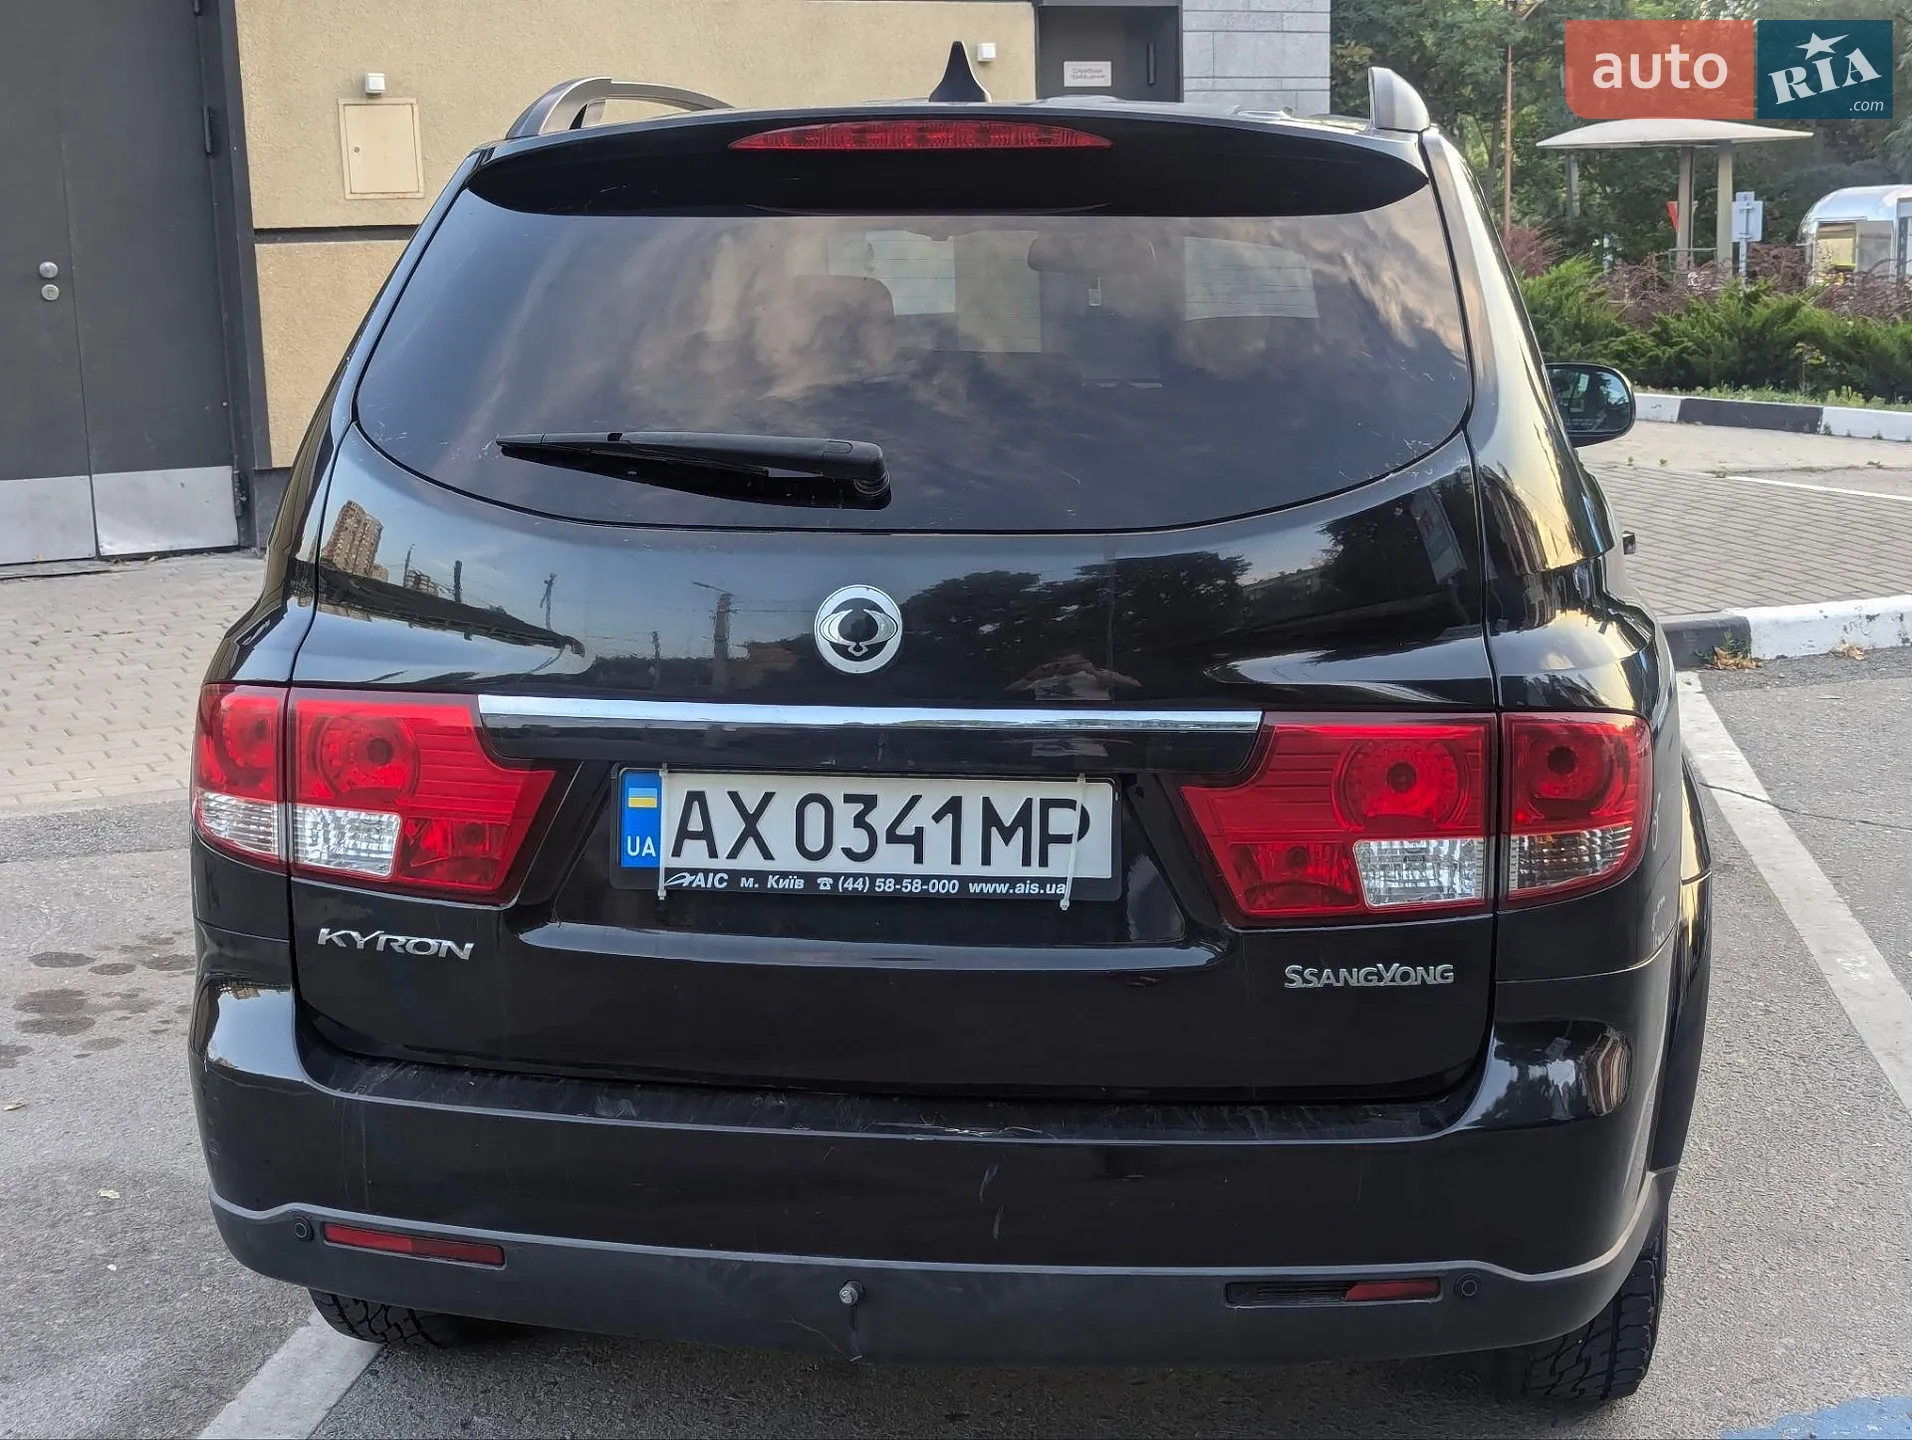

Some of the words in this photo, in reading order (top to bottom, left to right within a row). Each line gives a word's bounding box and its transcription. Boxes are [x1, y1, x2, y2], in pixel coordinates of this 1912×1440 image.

[670, 790, 776, 861] AX
[794, 793, 963, 865] 0341
[981, 796, 1091, 868] MP
[626, 835, 656, 857] UA
[740, 877, 759, 889] м.
[767, 875, 805, 890] Київ
[838, 875, 870, 893] (44)
[874, 877, 960, 894] 58-58-000
[968, 880, 1067, 894] www.ais.ua
[317, 927, 475, 961] KYRON
